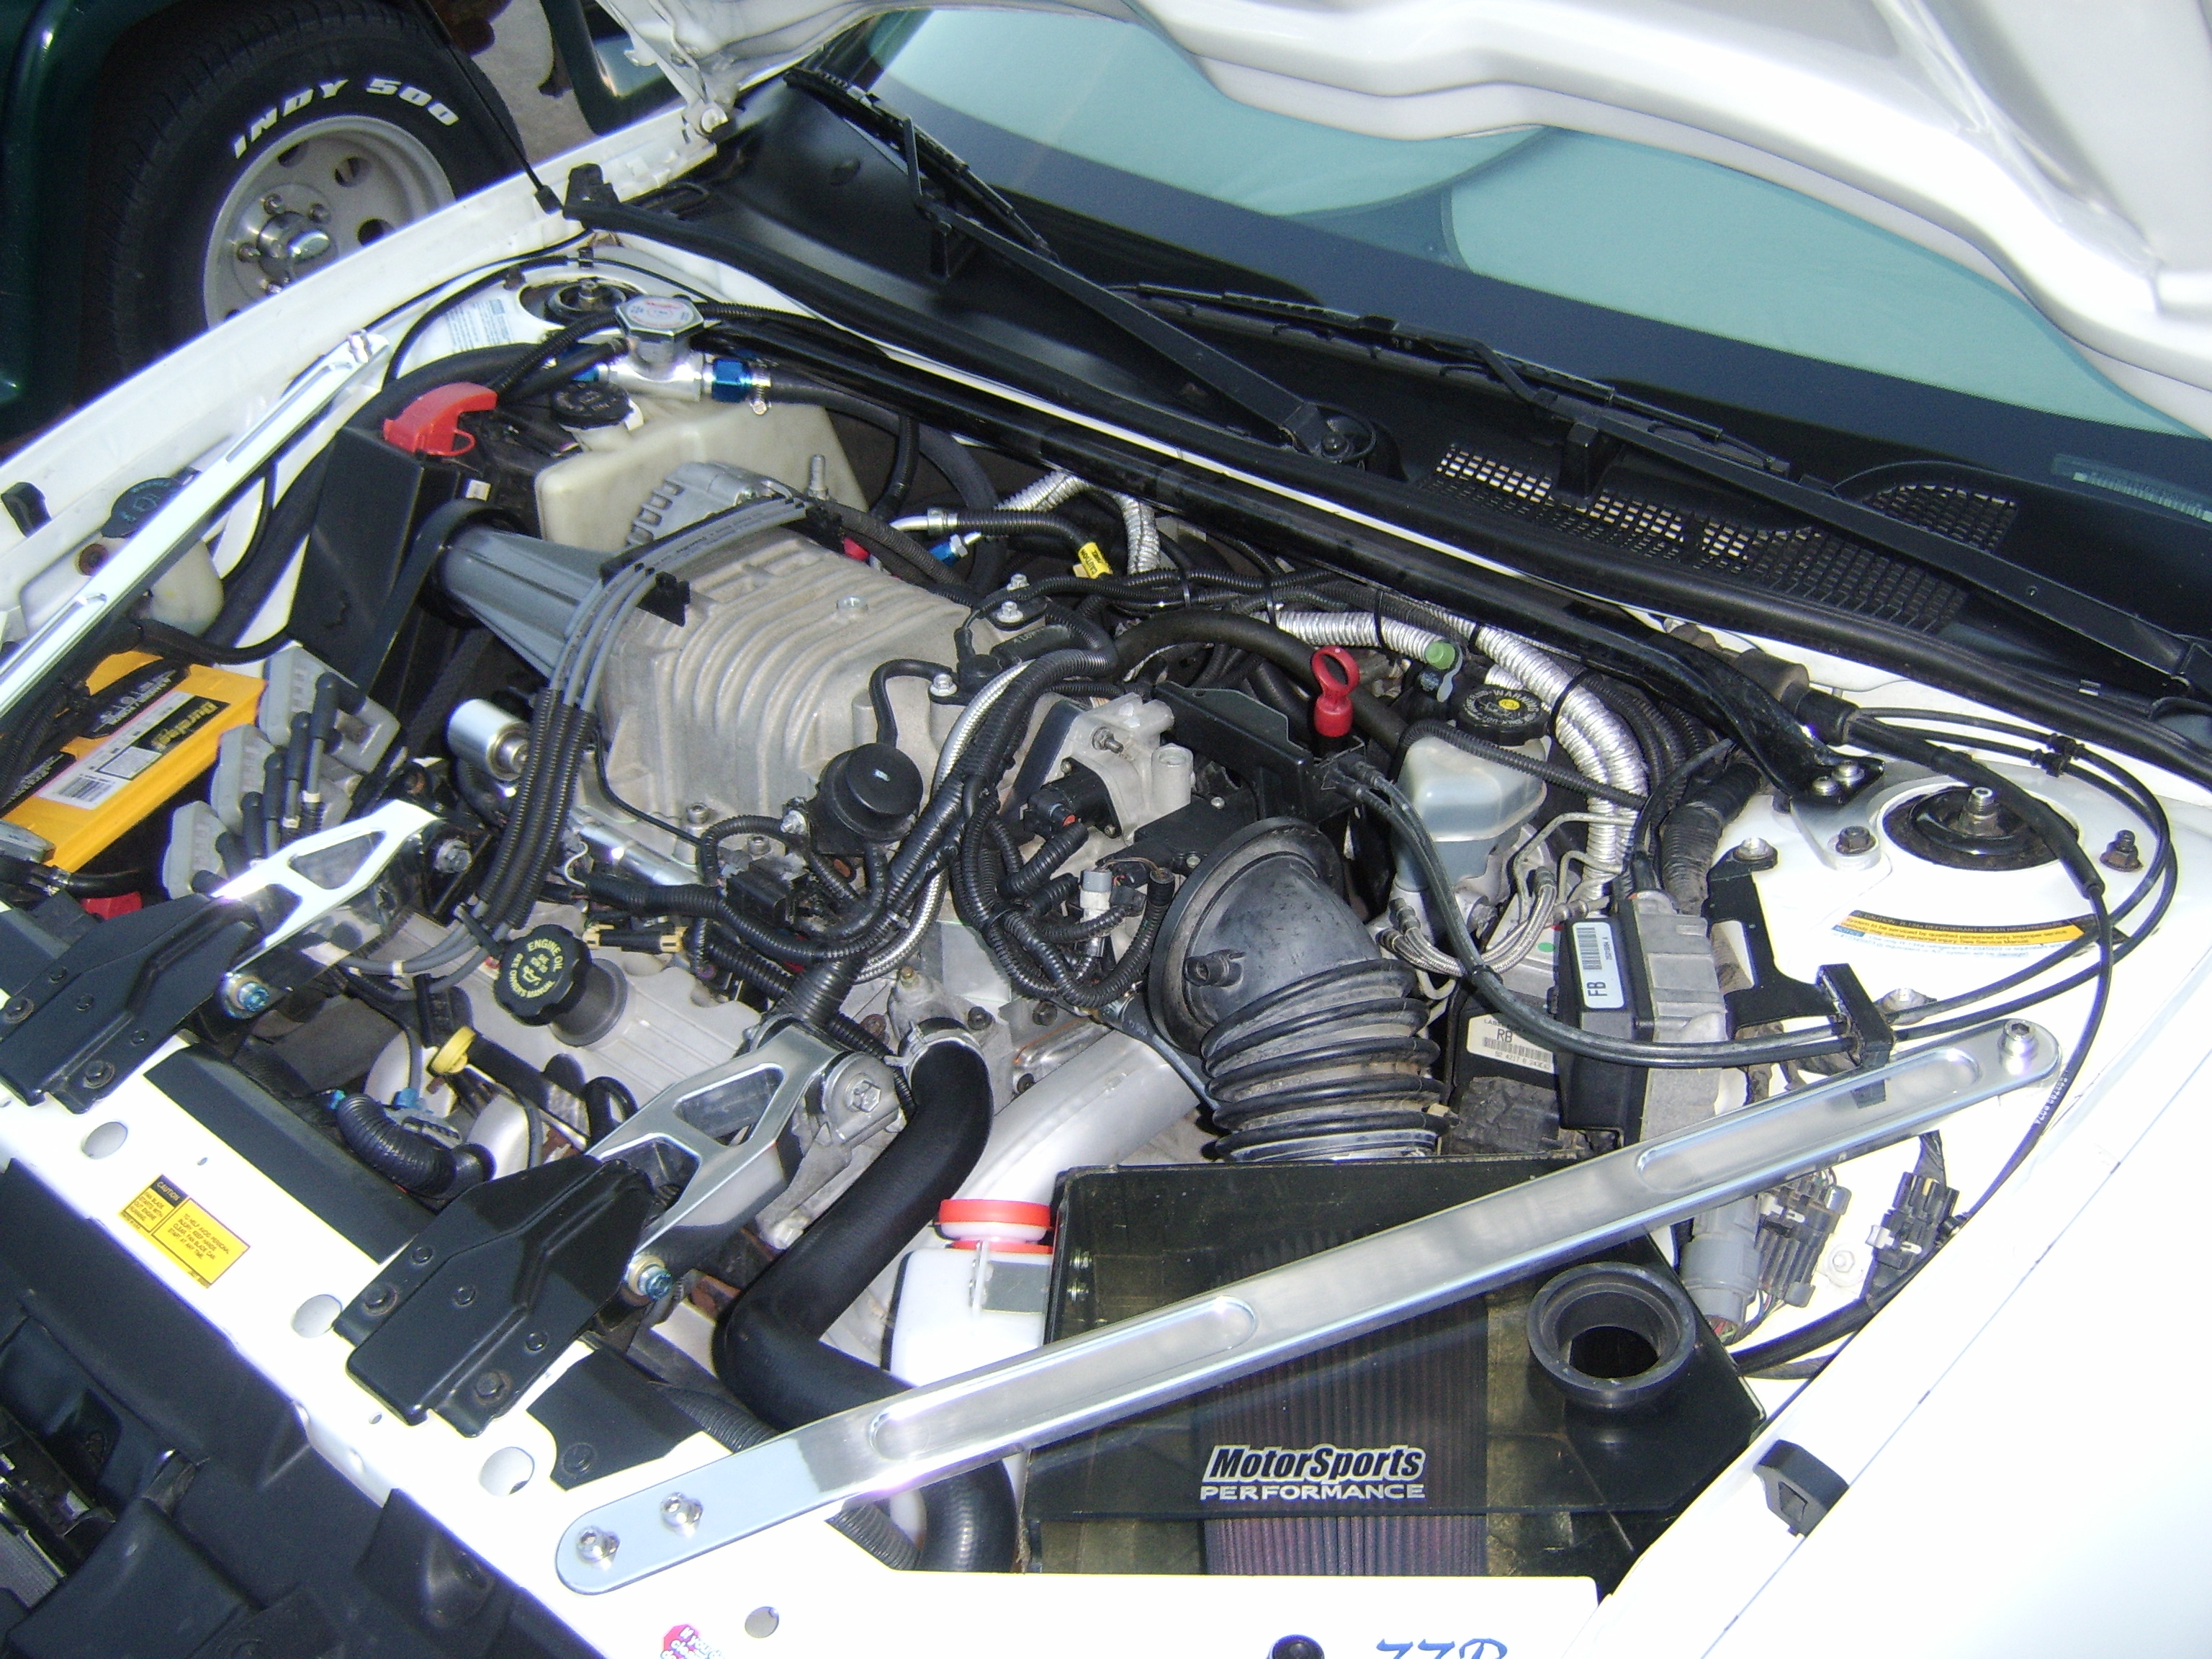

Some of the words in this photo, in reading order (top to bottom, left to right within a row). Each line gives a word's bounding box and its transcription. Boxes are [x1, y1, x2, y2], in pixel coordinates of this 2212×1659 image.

[233, 78, 349, 159] INDY
[366, 78, 459, 127] 500
[1493, 690, 1539, 712] WARNING
[527, 938, 562, 957] ENGINE
[552, 956, 564, 973] OIL
[526, 980, 556, 999] MANUAL
[1587, 980, 1607, 997] FB
[1496, 1028, 1514, 1043] RB
[156, 1180, 181, 1201] CAUTION
[1202, 1444, 1426, 1484] MotorSports
[1200, 1484, 1426, 1501] PERFORMANCE
